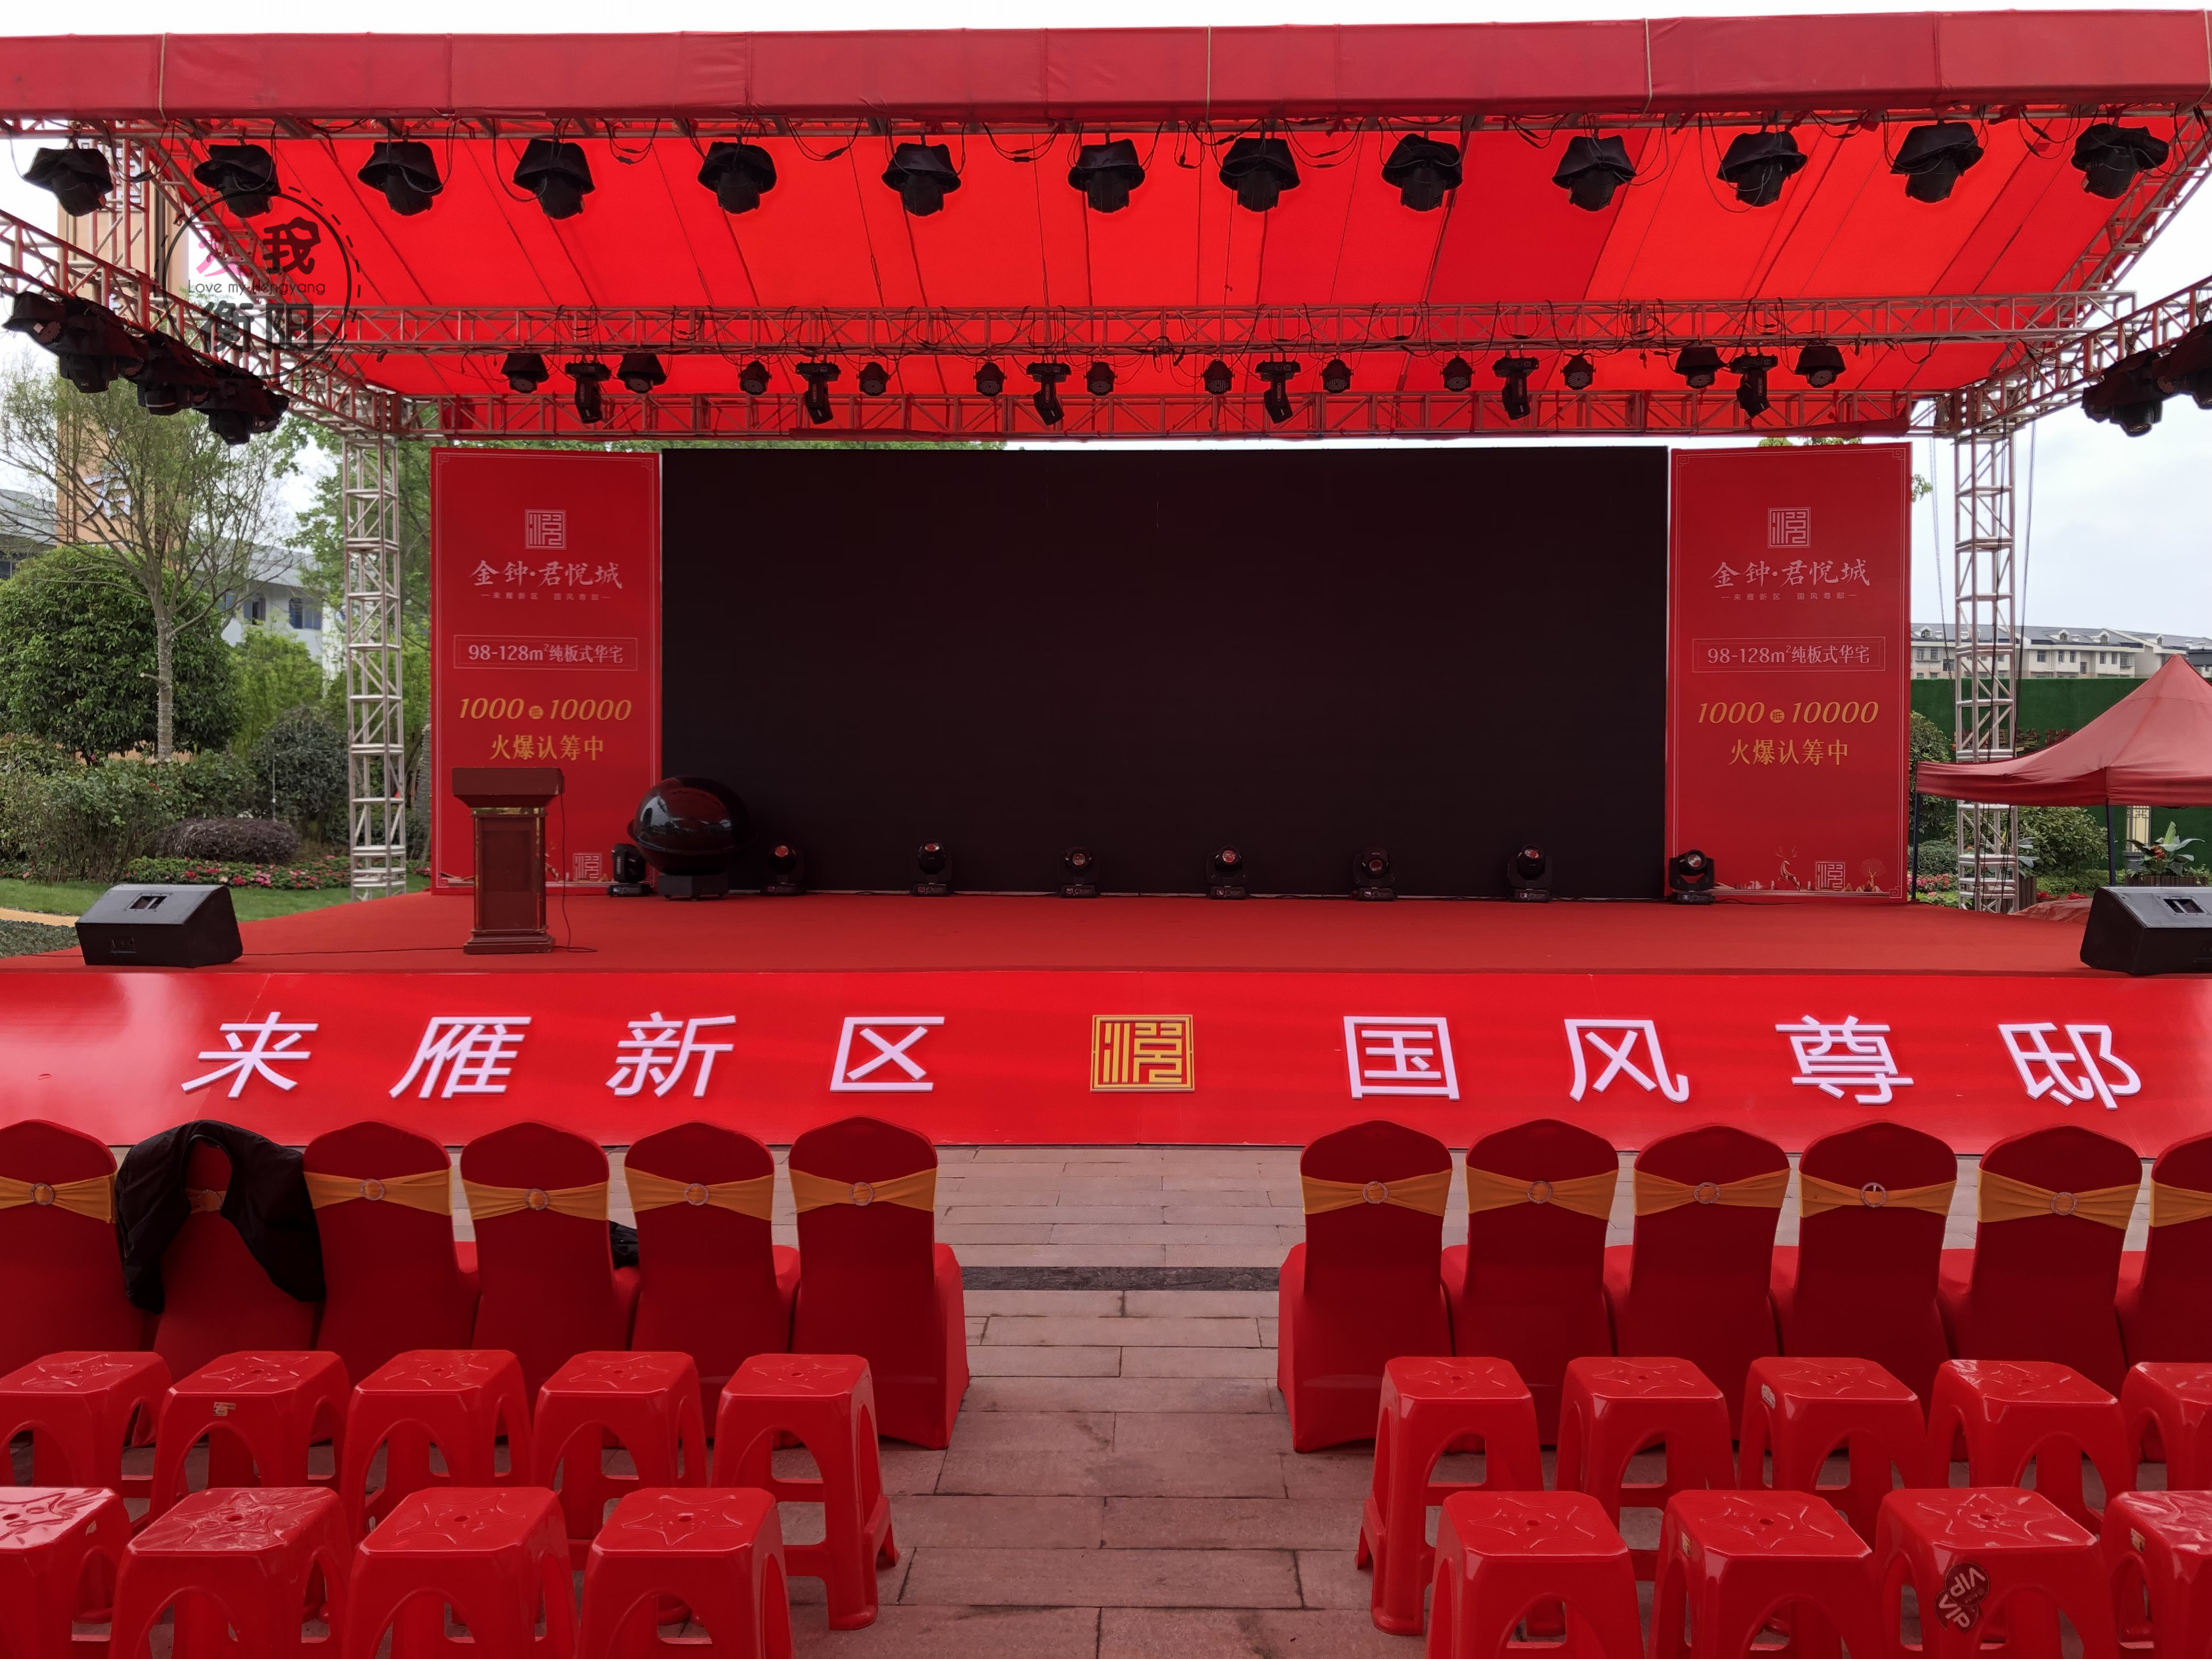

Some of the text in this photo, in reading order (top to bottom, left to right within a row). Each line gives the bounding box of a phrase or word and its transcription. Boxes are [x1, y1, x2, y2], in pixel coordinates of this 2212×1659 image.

[470, 560, 623, 589] 金钟·君悦城
[1709, 558, 1870, 588] 金钟·君悦城
[489, 734, 603, 761] 火爆认筹中
[1729, 738, 1848, 766] 火爆认筹中
[1950, 1567, 1986, 1598] VIP
[1938, 1593, 1970, 1628] VIP
